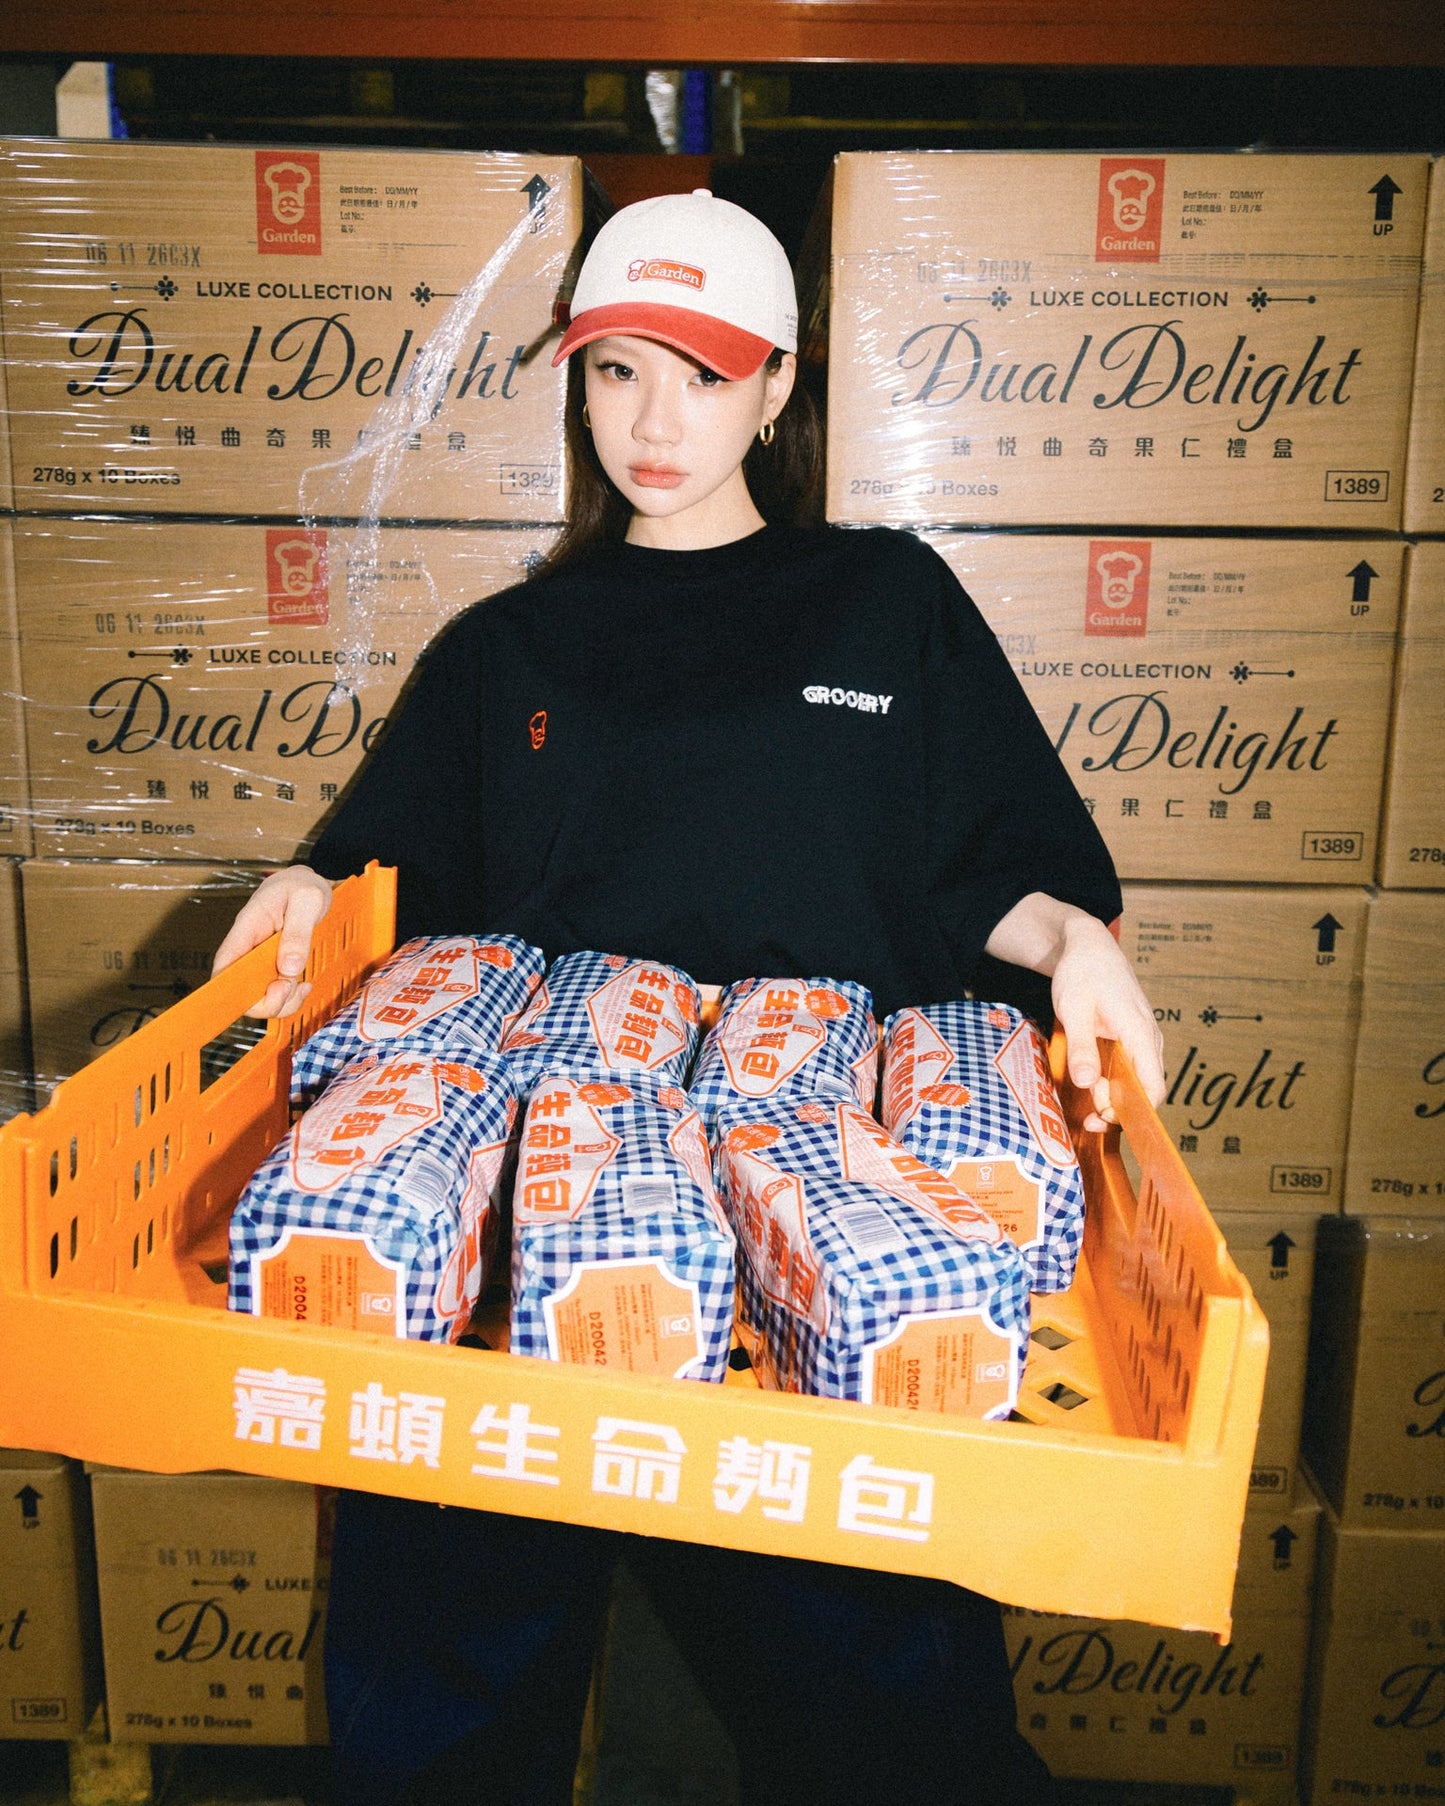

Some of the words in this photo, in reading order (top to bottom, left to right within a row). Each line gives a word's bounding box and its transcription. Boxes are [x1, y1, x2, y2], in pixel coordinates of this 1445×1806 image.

[262, 228, 316, 245] Garden
[1373, 224, 1394, 236] UP
[1101, 236, 1155, 251] Garden
[647, 263, 701, 286] Garden
[197, 281, 250, 298] LUXE
[257, 282, 392, 301] COLLECTION
[1031, 291, 1084, 307] LUXE
[1092, 292, 1228, 307] COLLECTION
[67, 308, 262, 396] Dual
[891, 319, 1093, 408] Dual
[1093, 320, 1362, 432] Delight
[33, 467, 77, 486] 278g
[943, 481, 999, 496] Boxes
[1334, 479, 1380, 494] 1389
[1350, 605, 1370, 617] UP
[1089, 612, 1142, 628] Garden
[210, 650, 262, 664] LUXE
[1021, 662, 1073, 677] LUXE
[1080, 663, 1211, 679] COLLECTION
[86, 673, 272, 754] Dual
[1081, 690, 1339, 795] Delight
[142, 820, 195, 836] Boxes
[1310, 838, 1355, 854] 1389
[1316, 955, 1336, 966] UP
[1279, 1172, 1323, 1188] 1389
[1371, 1179, 1414, 1197] 278g
[265, 1578, 311, 1592] LUXE
[155, 1597, 321, 1663] Dual
[1033, 1627, 1264, 1715] Delight
